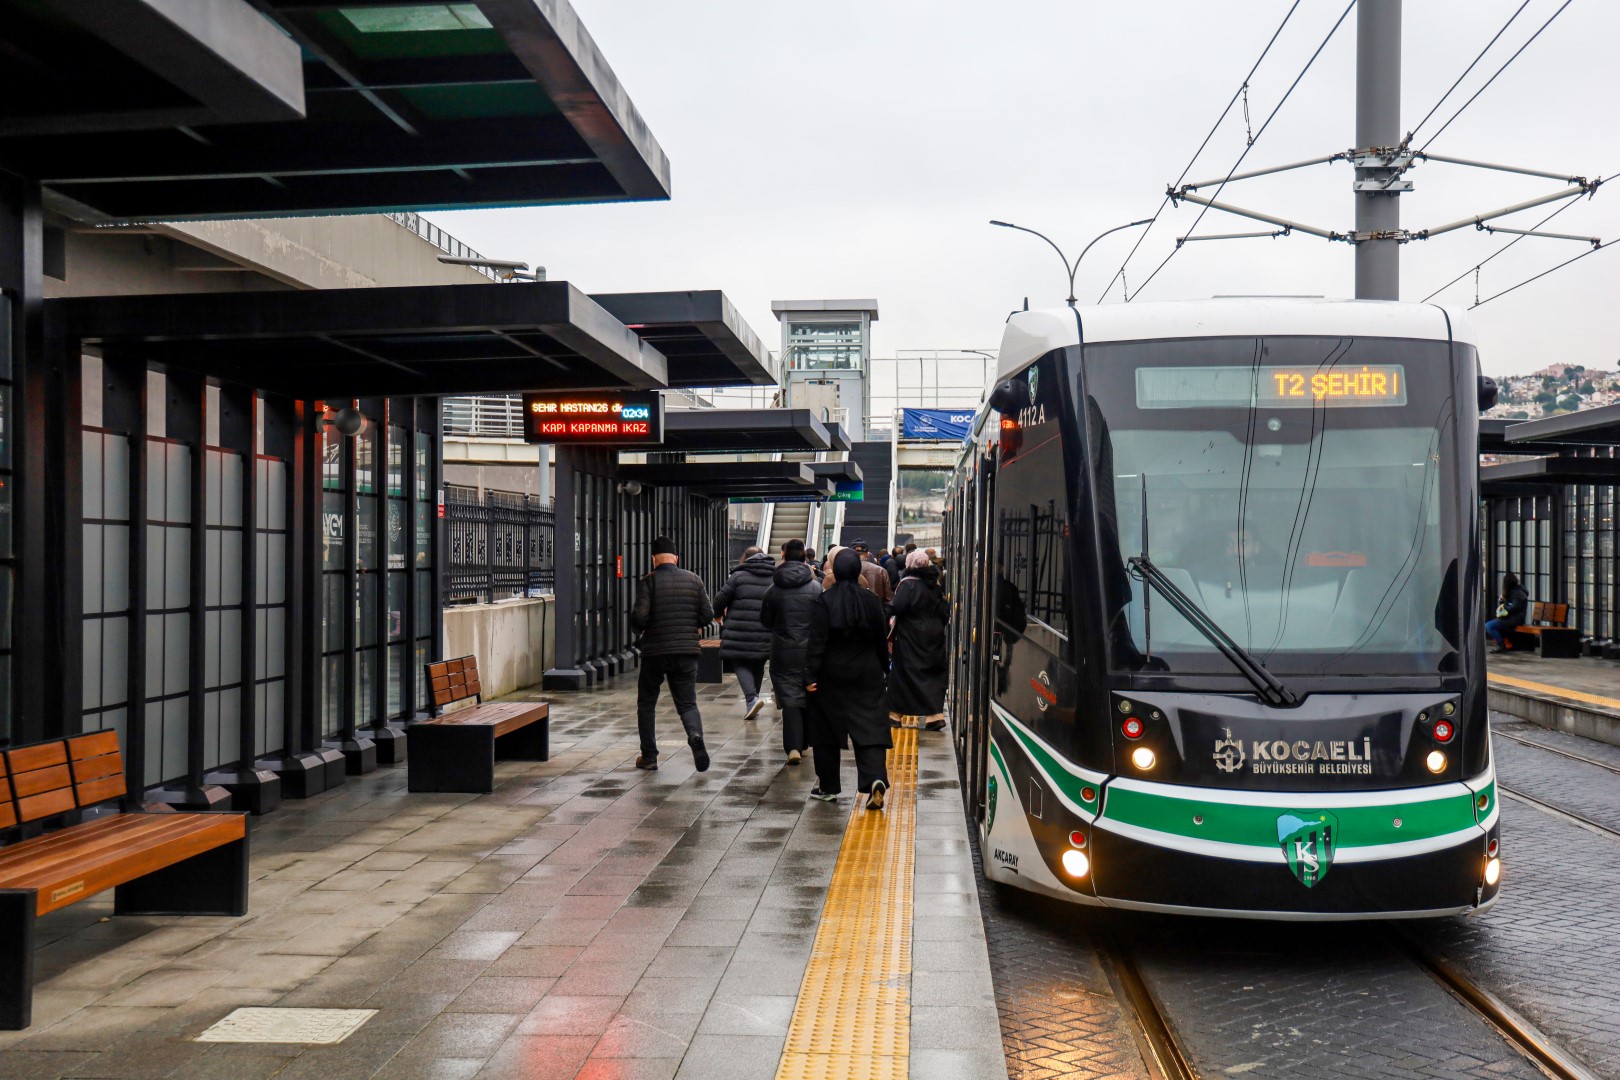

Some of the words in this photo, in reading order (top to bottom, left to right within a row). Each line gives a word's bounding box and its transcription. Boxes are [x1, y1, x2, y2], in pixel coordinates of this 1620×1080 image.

[1274, 374, 1304, 396] T2
[1311, 365, 1387, 402] ŞEHİR
[1017, 406, 1037, 428] 4112
[1038, 403, 1046, 425] A
[543, 423, 566, 433] KAPI
[571, 423, 618, 433] KAPANMA
[1253, 737, 1371, 760] KOCAELİ
[1253, 762, 1314, 775] BÜYÜKŞEHİR
[1320, 762, 1372, 775] BELEDİYESİ
[994, 848, 1019, 867] AKÇARAY
[1294, 841, 1319, 872] KS
